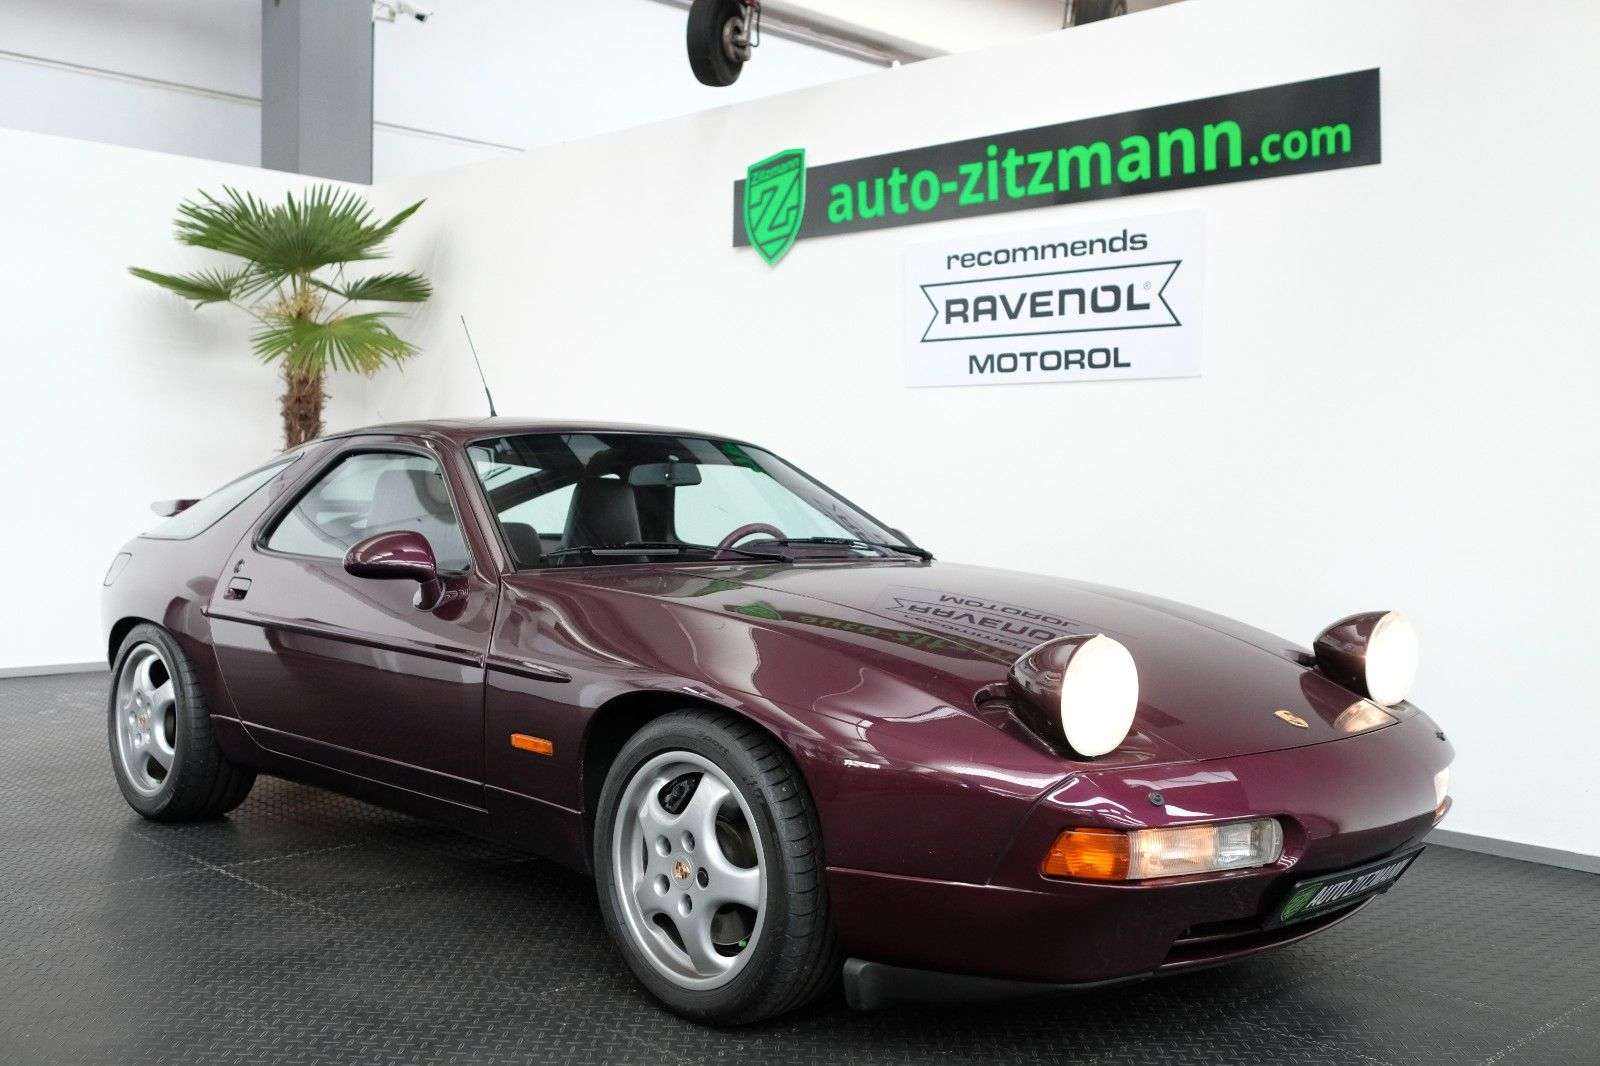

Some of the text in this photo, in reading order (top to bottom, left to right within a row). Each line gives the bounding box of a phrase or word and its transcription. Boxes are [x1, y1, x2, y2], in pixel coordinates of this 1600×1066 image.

[827, 120, 1352, 224] auto-zitzmann.com
[947, 229, 1148, 270] recommends
[968, 347, 1131, 374] MOTOROL
